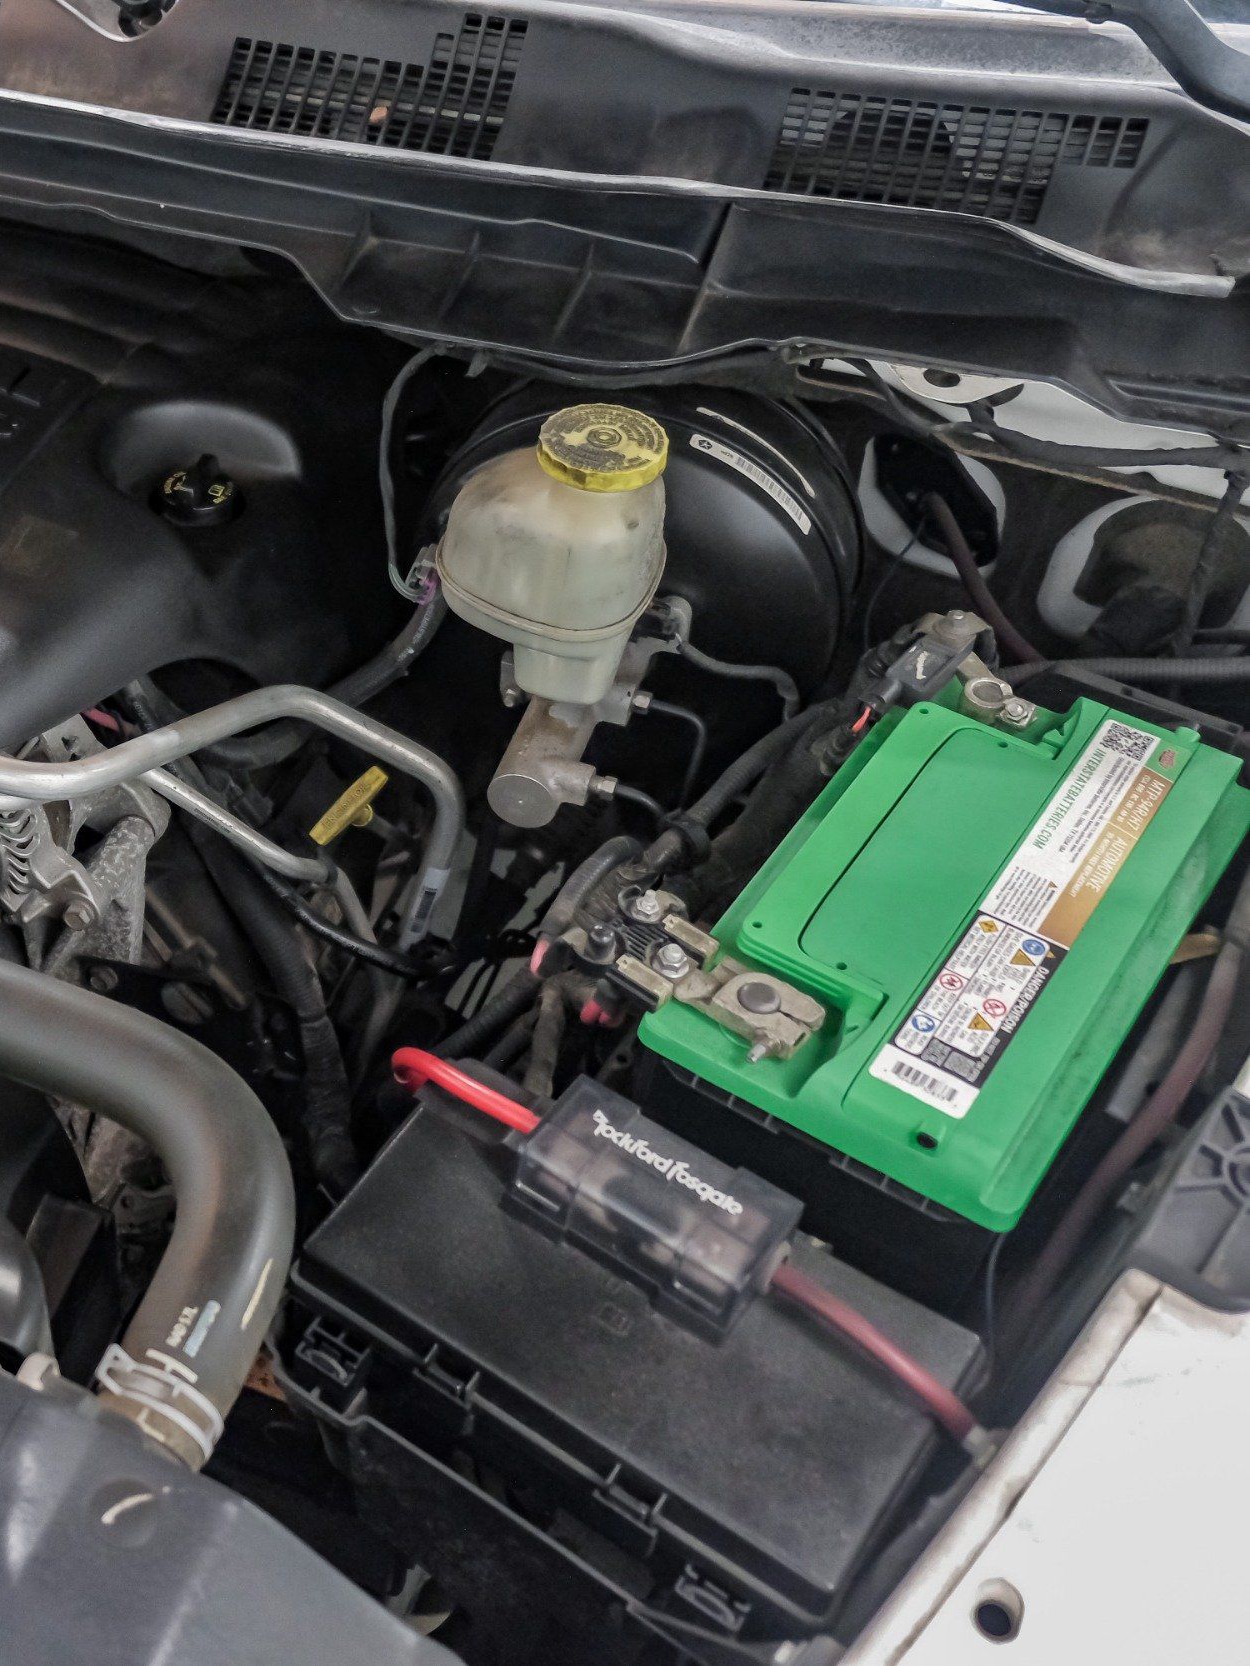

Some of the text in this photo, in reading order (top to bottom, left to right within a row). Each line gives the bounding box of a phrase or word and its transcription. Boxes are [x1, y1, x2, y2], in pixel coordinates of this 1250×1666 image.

[1033, 750, 1106, 850] INTERSTATEBATTERIES.COM
[1127, 779, 1165, 831] MTP-94R/H7
[1086, 837, 1126, 893] AUTOMOTIVE
[1001, 966, 1050, 1034] DANGER/POISON
